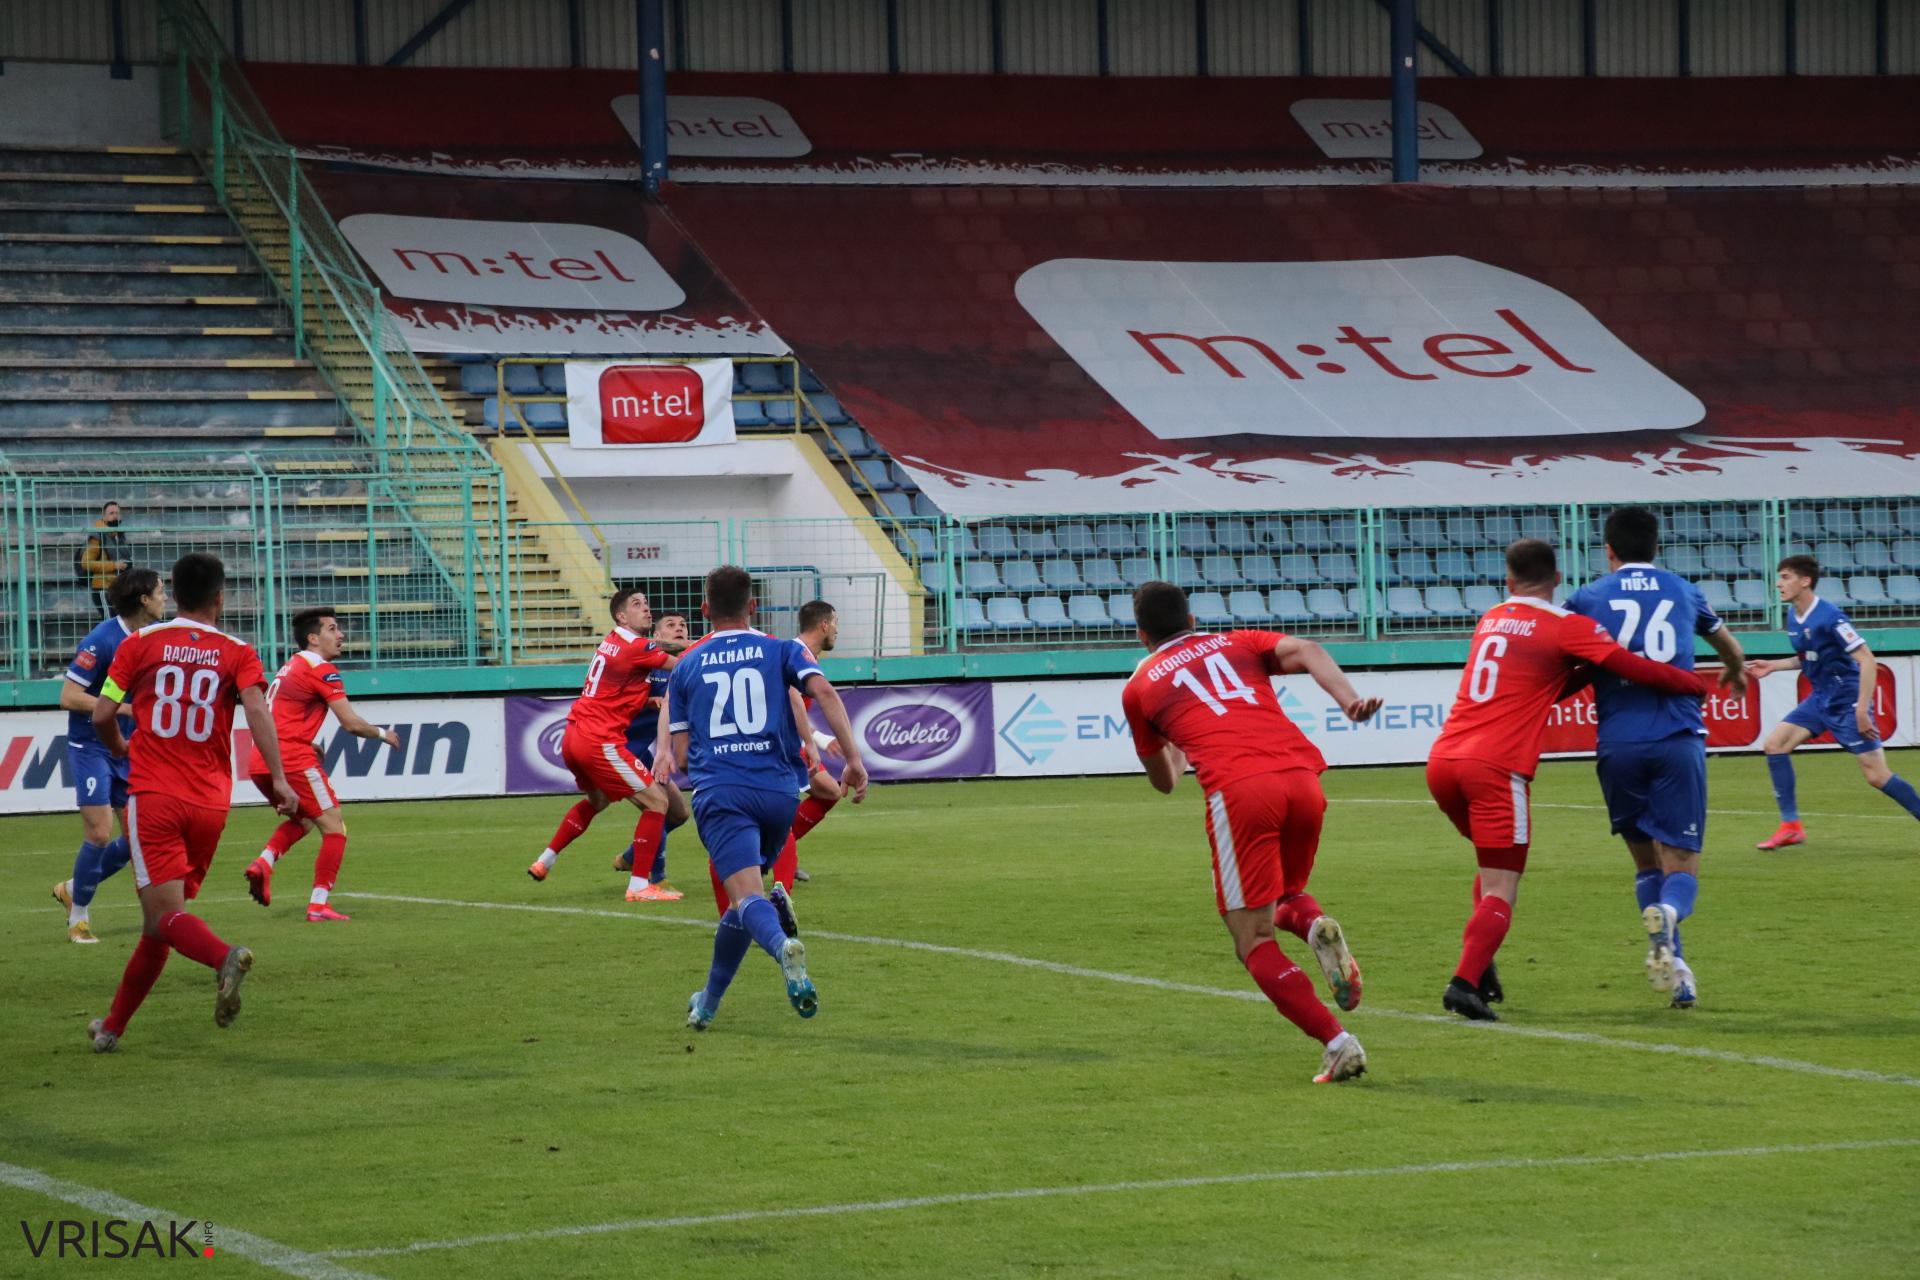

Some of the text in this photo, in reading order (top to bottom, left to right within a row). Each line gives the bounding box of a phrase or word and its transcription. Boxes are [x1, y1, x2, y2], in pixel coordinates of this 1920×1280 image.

[391, 248, 636, 283] m:tel
[1125, 308, 1596, 381] m:tel
[612, 386, 692, 418] m:tel
[627, 546, 660, 559] EXIT
[1621, 577, 1659, 591] MUSA
[1608, 599, 1676, 664] 26
[701, 646, 764, 667] ZACHARA
[1469, 635, 1508, 702] 6
[1172, 652, 1259, 717] 14
[152, 664, 220, 743] 88
[702, 667, 767, 738] 20
[876, 719, 950, 745] Violeta
[86, 776, 97, 796] 9
